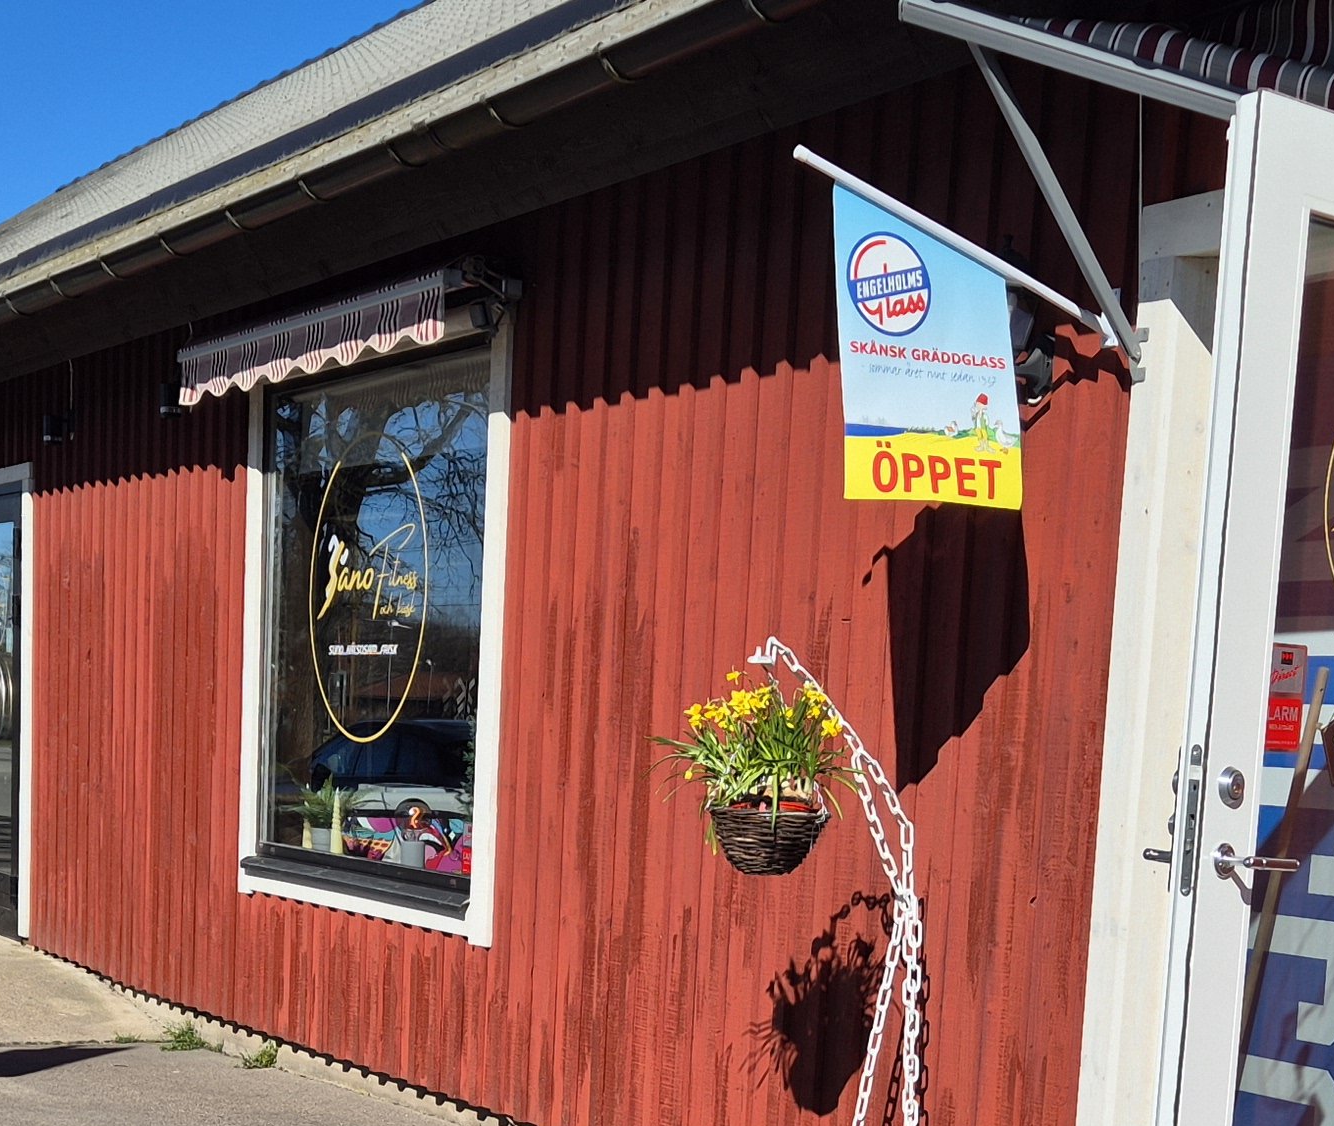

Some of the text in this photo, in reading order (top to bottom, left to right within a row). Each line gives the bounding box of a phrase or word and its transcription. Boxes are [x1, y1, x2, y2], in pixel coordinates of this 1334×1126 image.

[856, 270, 923, 299] ENGELHOLMS
[850, 340, 1006, 369] SKÅNSK GRÄDDGLASS
[872, 440, 1002, 500] ÖPPET
[369, 523, 418, 620] Fitness
